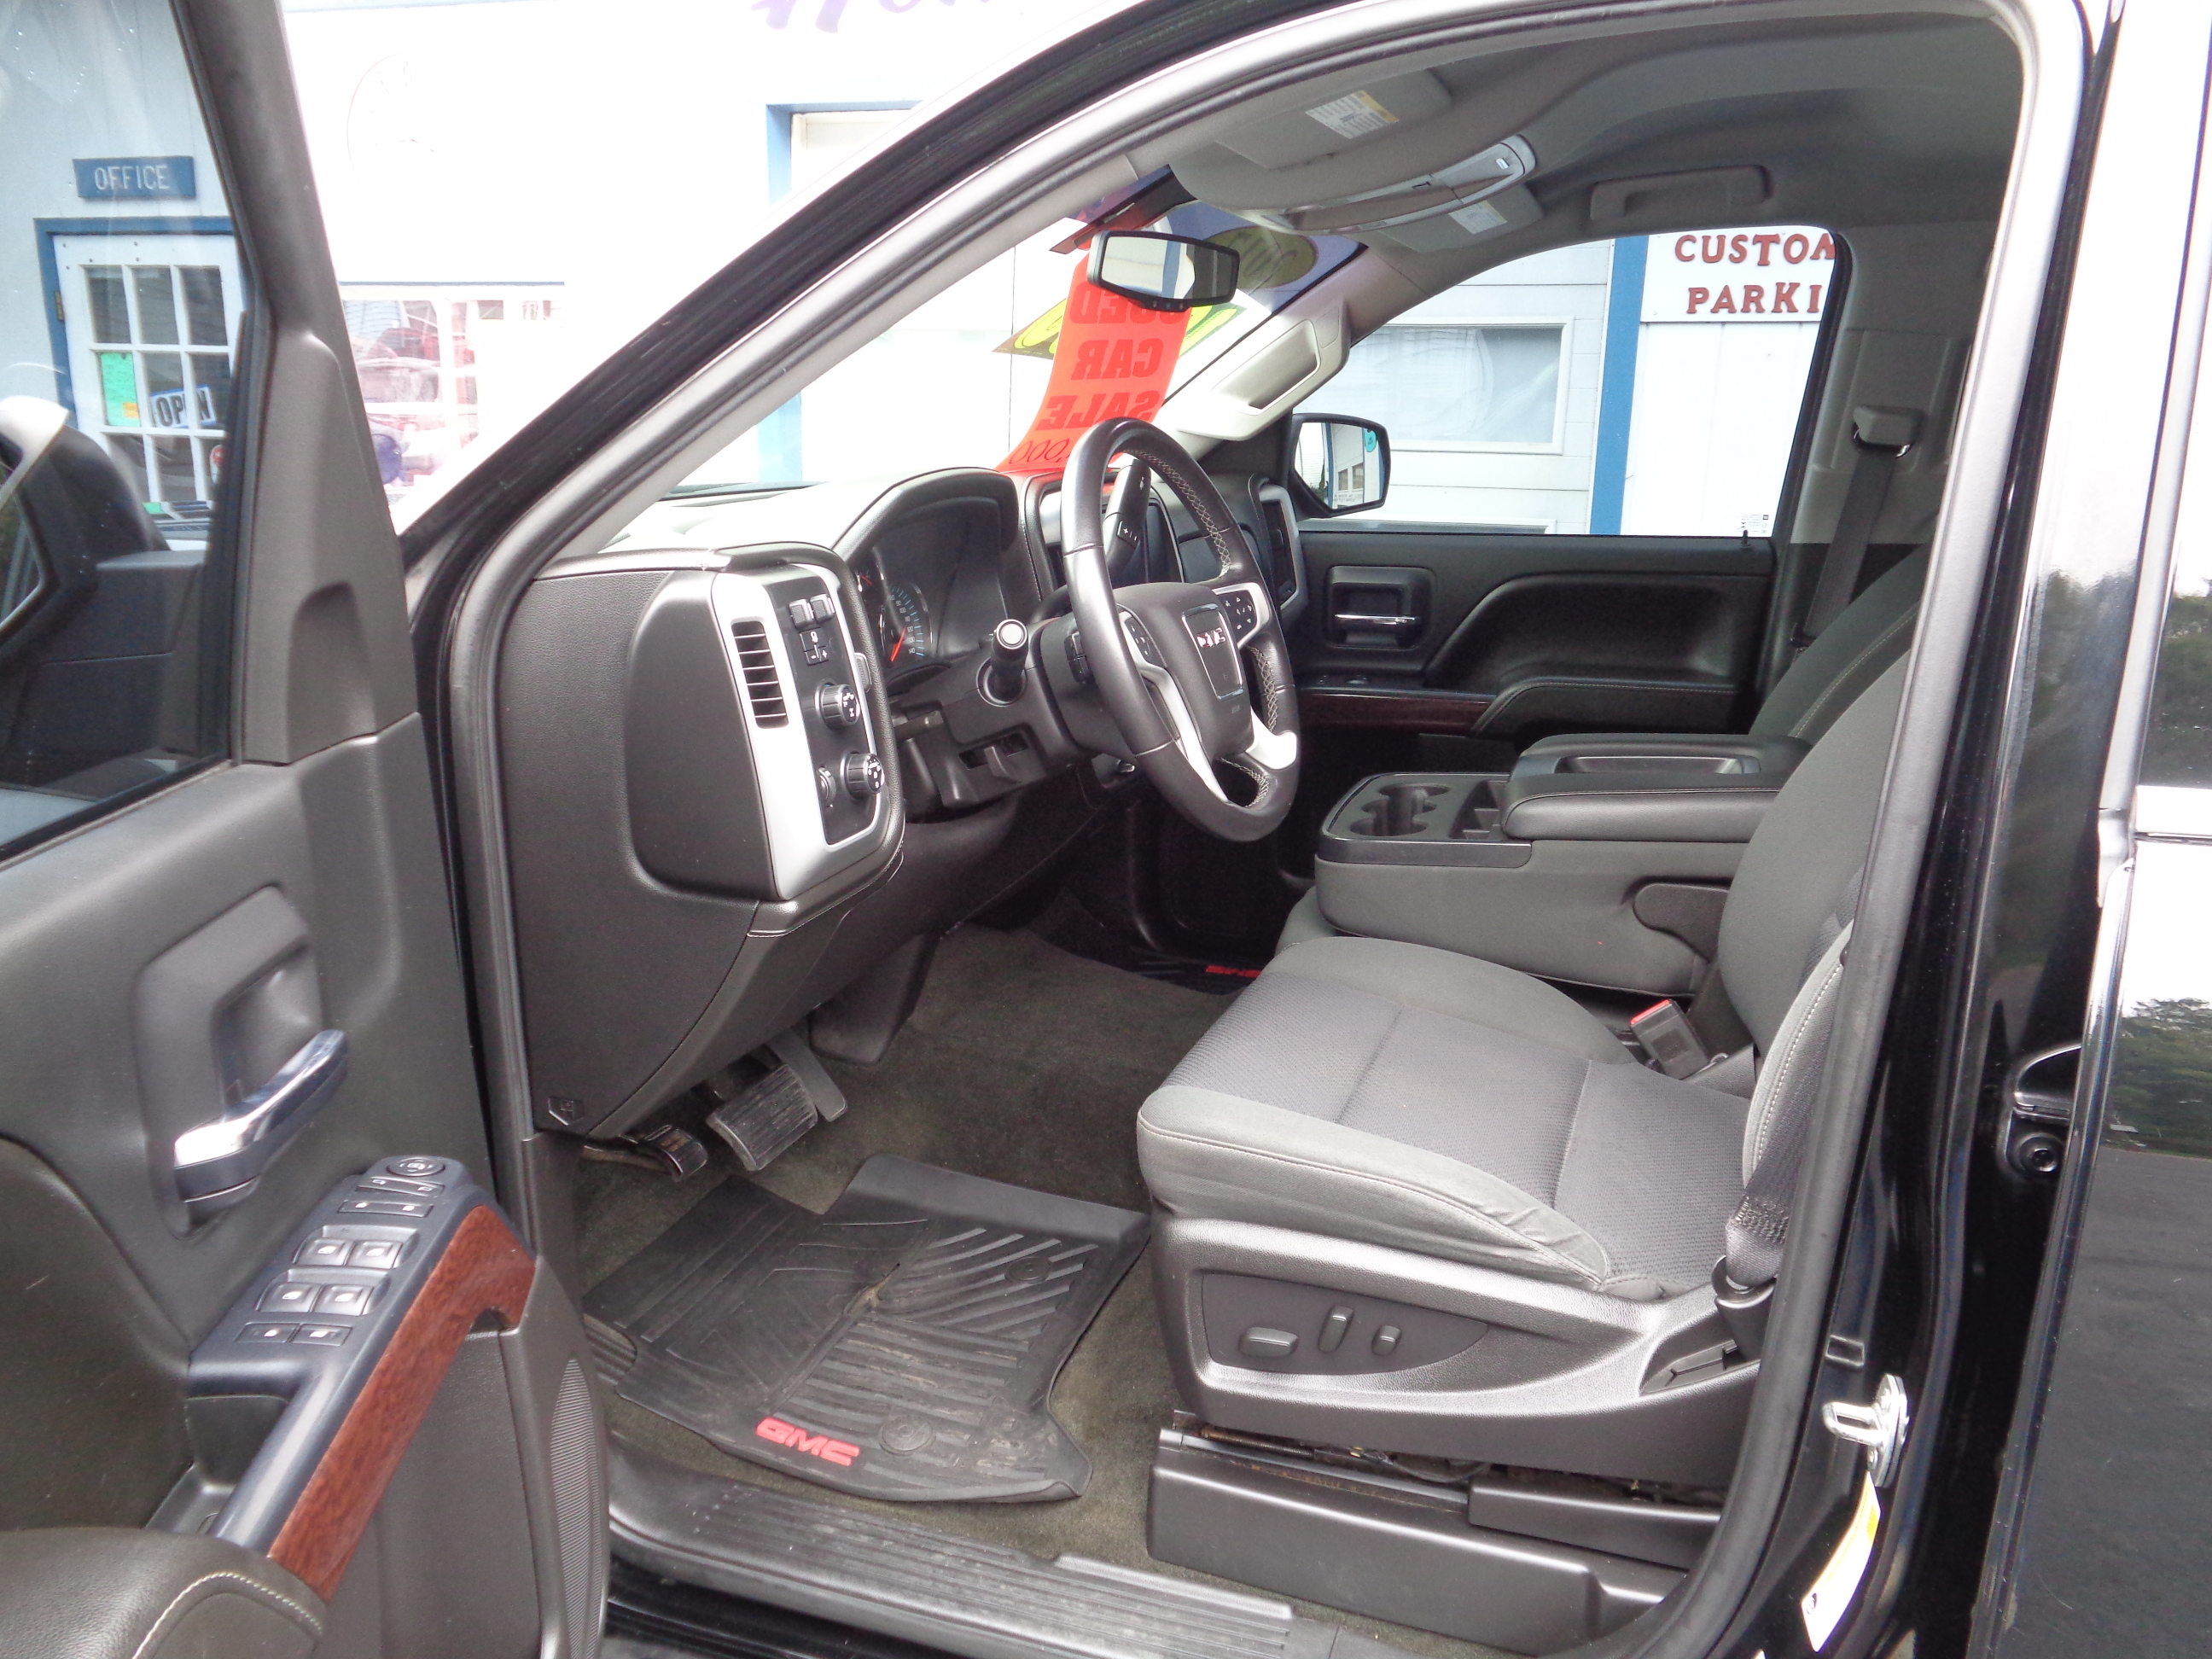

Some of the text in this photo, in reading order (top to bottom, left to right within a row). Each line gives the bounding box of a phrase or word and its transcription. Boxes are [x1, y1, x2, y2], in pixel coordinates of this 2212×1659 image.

[94, 164, 170, 190] OFFICE
[155, 389, 212, 428] OPN
[756, 1417, 860, 1467] GMC
